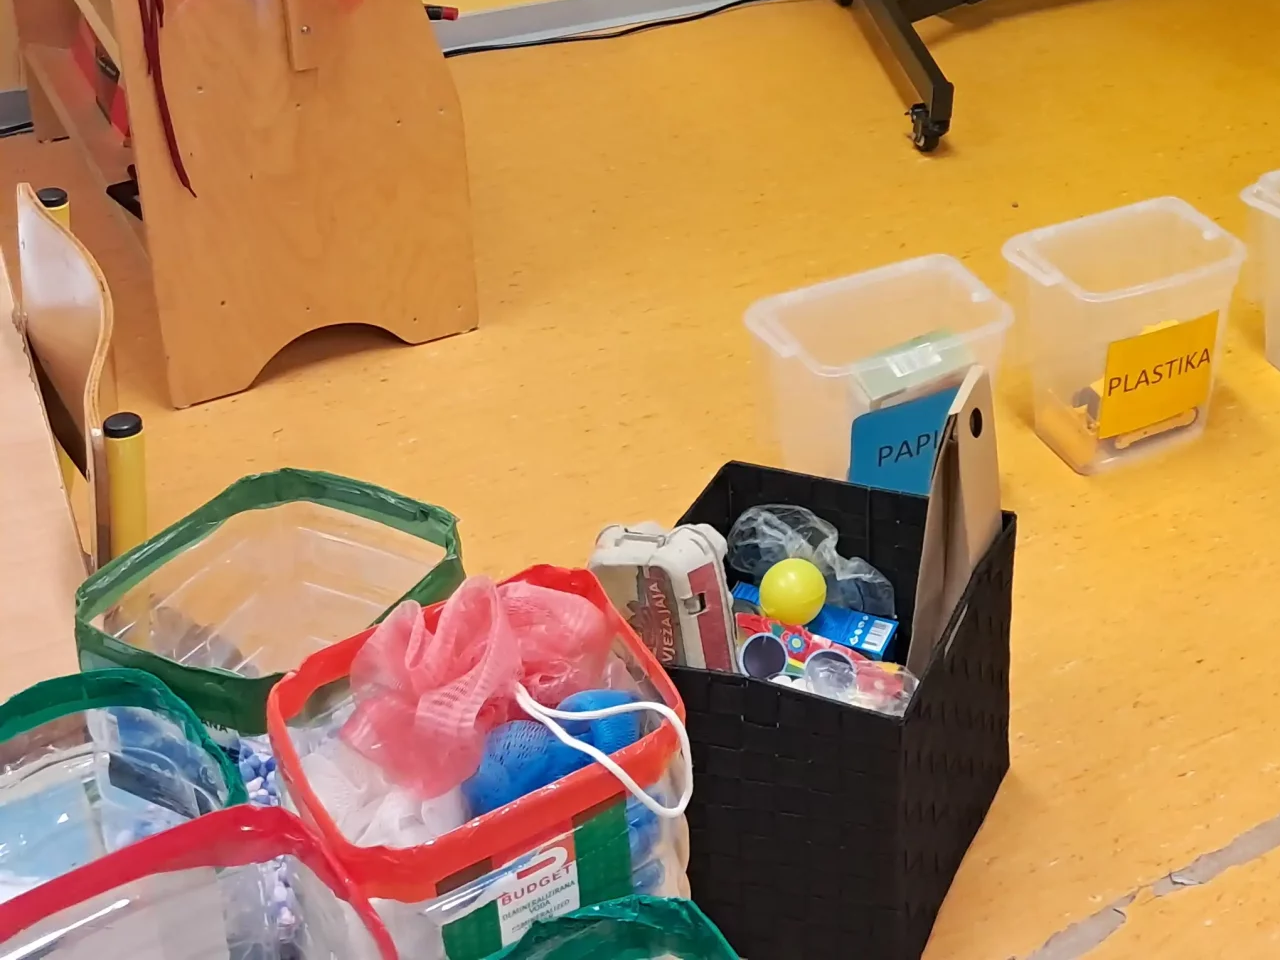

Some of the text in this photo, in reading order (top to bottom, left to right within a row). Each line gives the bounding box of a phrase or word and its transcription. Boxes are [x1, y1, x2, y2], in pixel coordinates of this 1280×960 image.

[1107, 347, 1211, 397] PLASTIKA
[877, 429, 939, 468] PAPI
[648, 581, 671, 615] JAJA
[501, 863, 574, 907] BUDGET
[502, 880, 576, 921] DEMINERALIZIRANA
[529, 900, 551, 914] VODA
